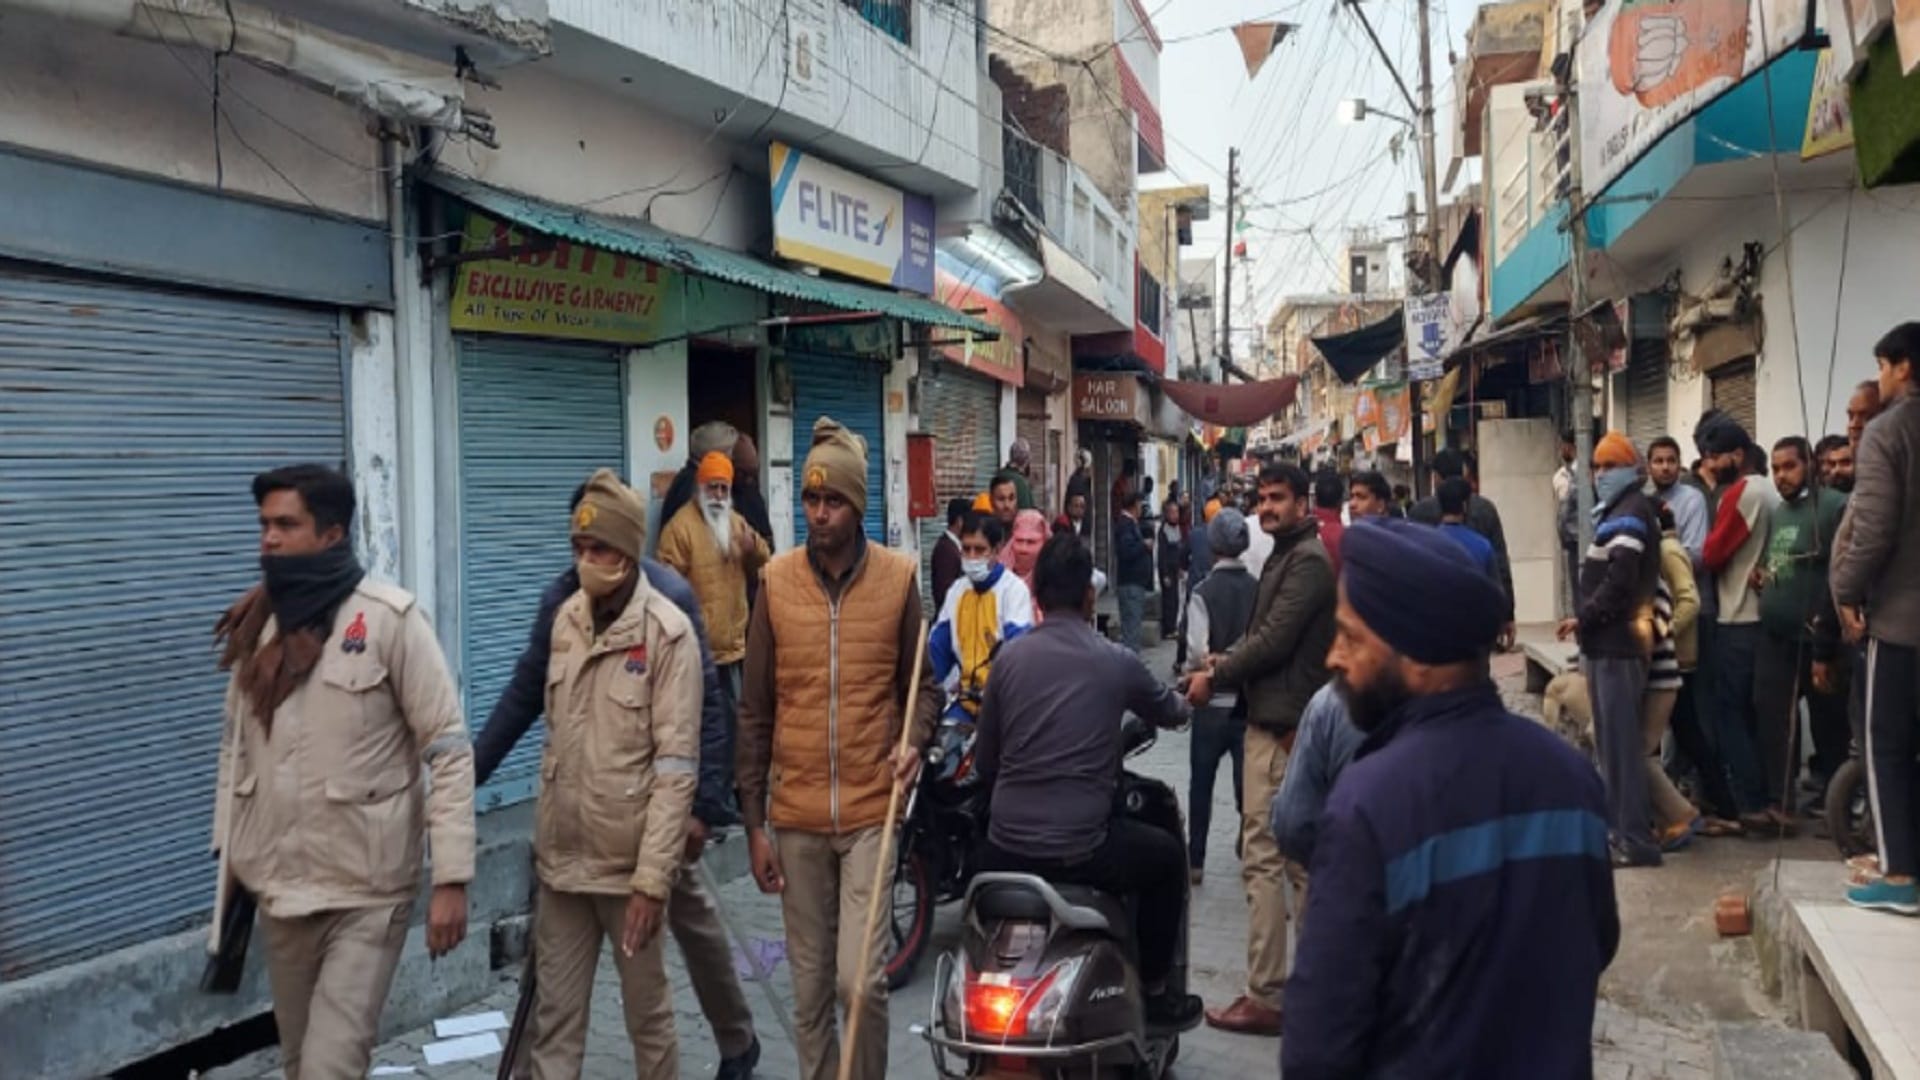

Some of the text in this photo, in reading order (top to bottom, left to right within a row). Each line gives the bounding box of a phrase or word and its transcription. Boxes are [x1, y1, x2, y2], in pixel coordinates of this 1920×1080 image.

[798, 180, 869, 243] FLITE
[468, 271, 656, 315] EXCLUSIVE GARMENTS
[464, 302, 485, 316] All
[1081, 397, 1128, 415] SALOON
